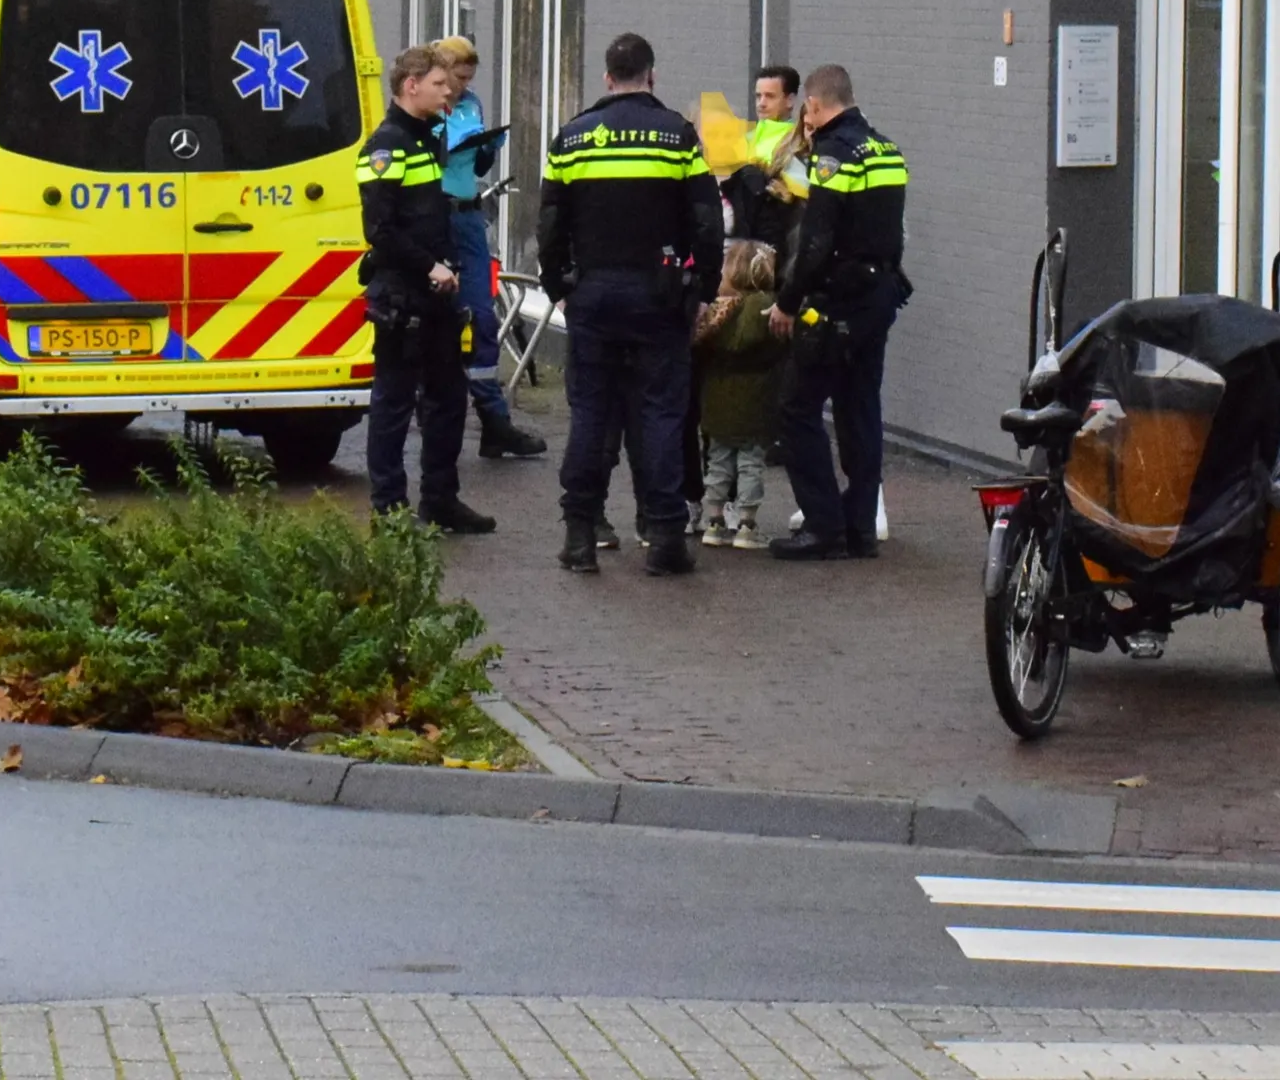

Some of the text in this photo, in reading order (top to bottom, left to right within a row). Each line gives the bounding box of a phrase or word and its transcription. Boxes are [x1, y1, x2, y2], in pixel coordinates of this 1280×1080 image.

[70, 182, 177, 210] 07116
[254, 185, 293, 207] 1-1-2
[48, 328, 141, 349] PS-150-P
